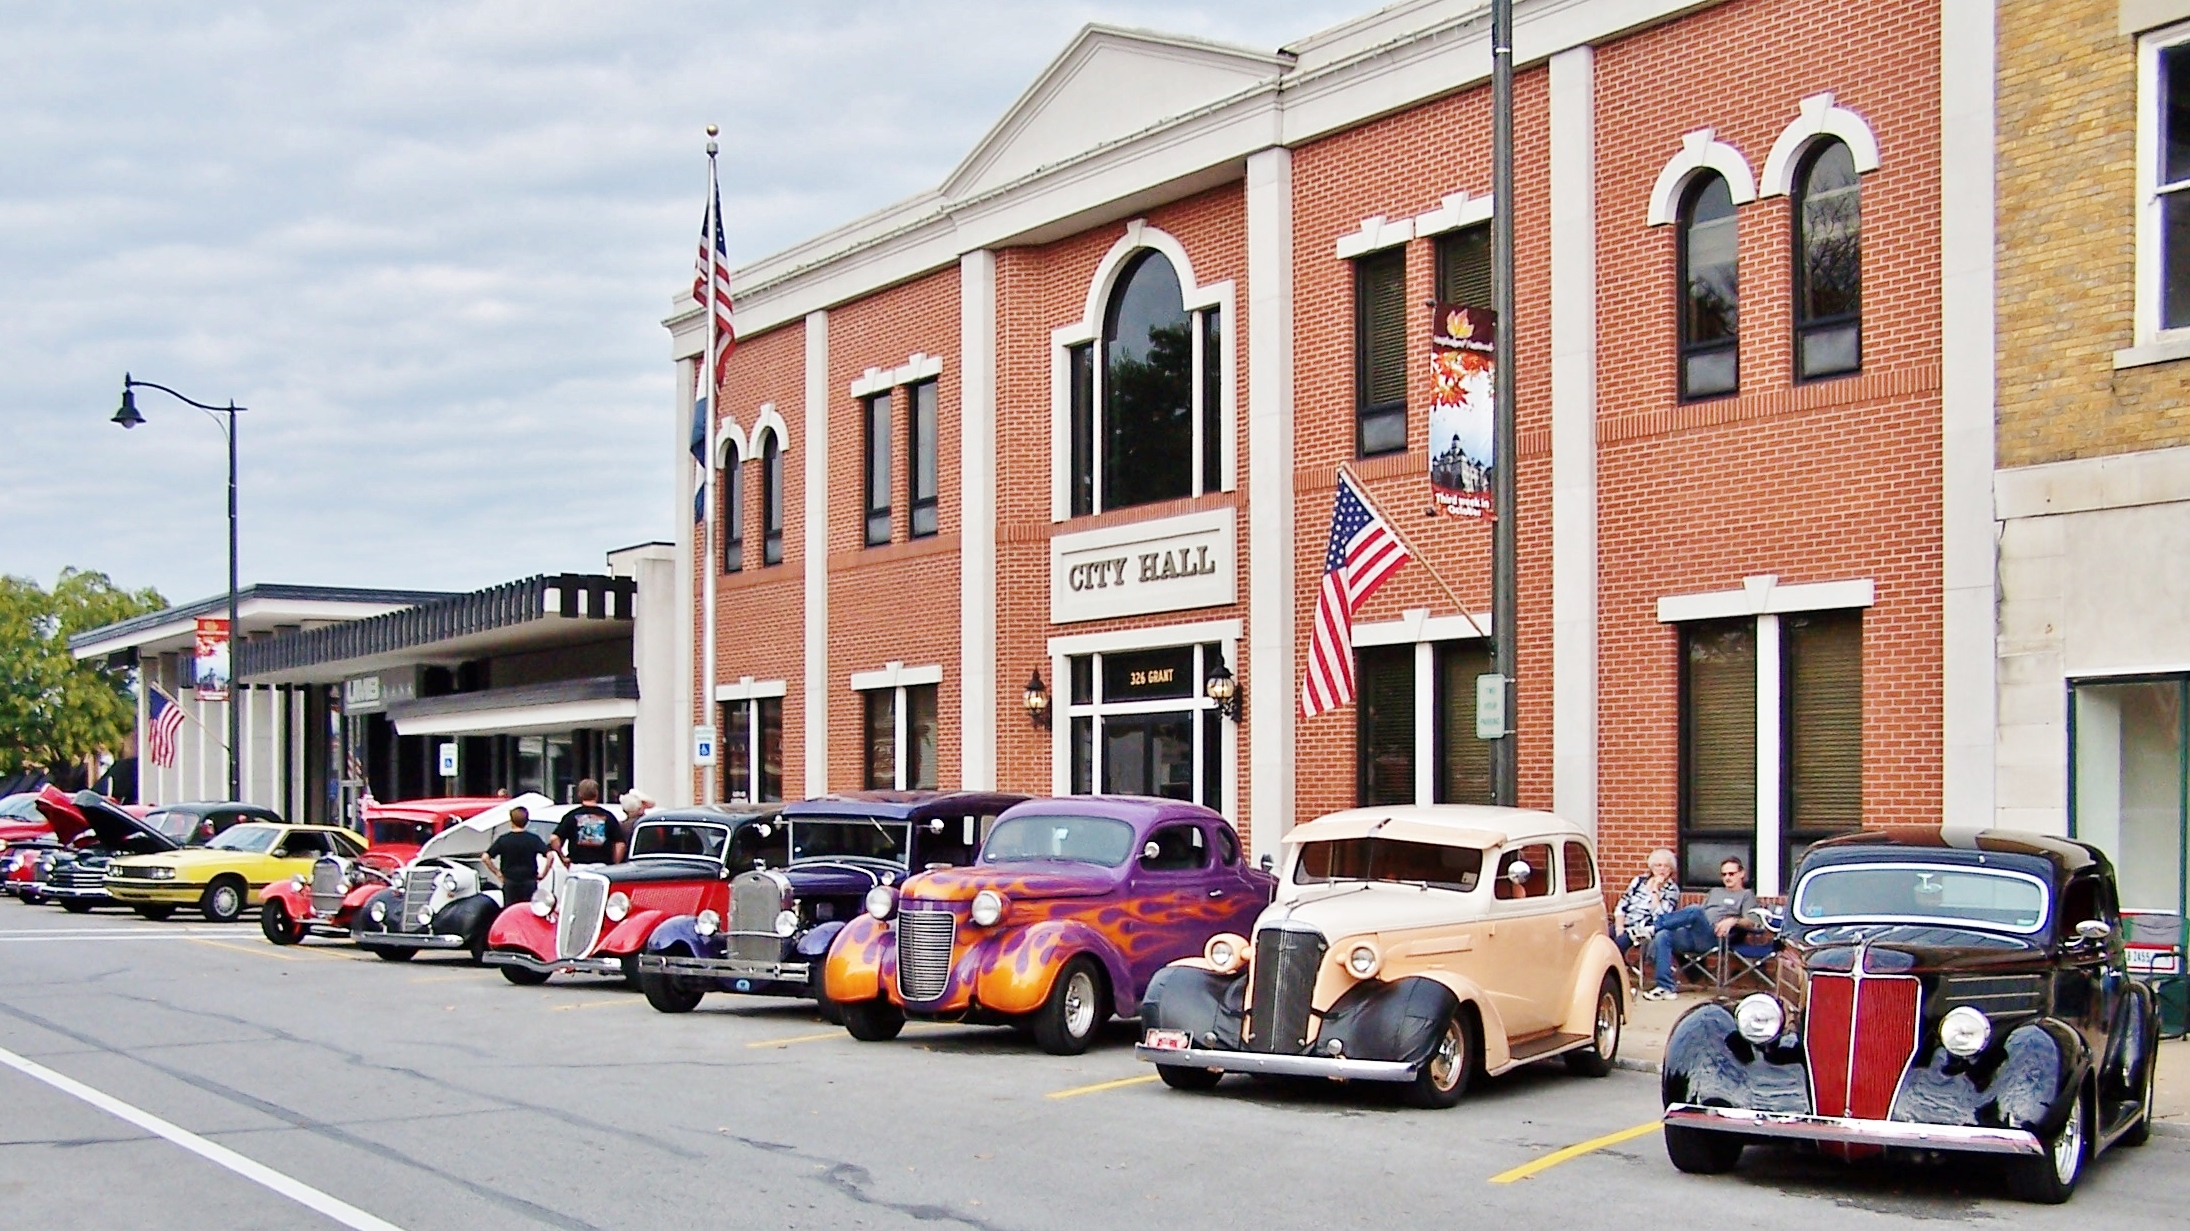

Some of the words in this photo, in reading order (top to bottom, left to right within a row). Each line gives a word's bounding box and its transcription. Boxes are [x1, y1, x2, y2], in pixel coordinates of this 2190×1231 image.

[1435, 492, 1458, 505] Third
[1068, 557, 1128, 592] CITY
[1138, 545, 1216, 583] HALL
[1130, 671, 1146, 685] 326
[1148, 669, 1174, 683] GRANT
[347, 676, 380, 703] UMB
